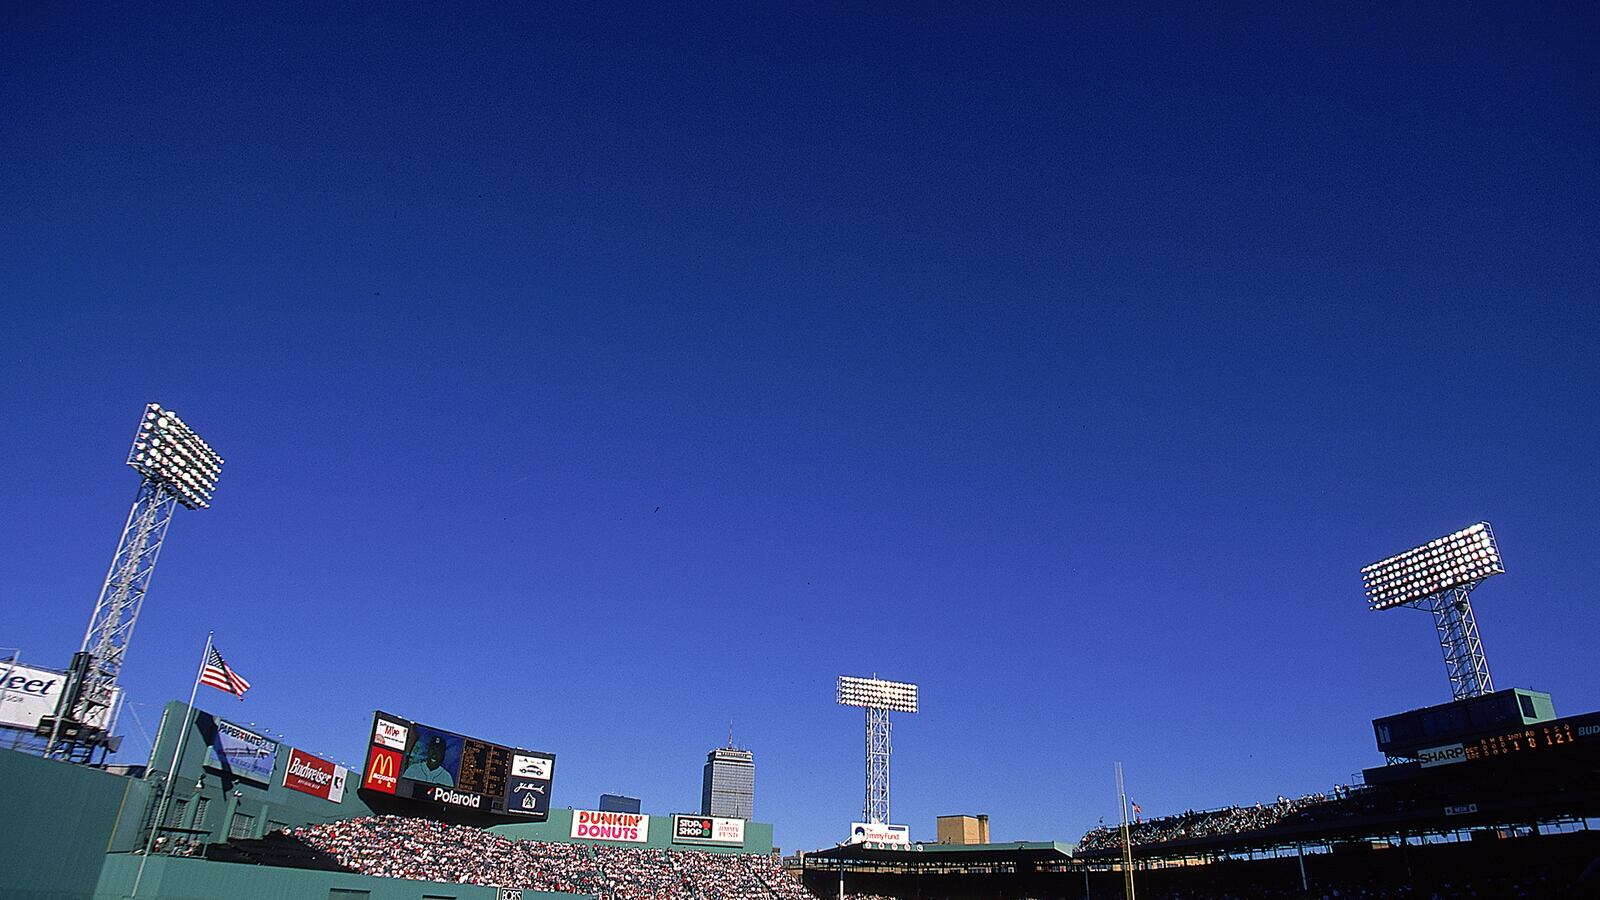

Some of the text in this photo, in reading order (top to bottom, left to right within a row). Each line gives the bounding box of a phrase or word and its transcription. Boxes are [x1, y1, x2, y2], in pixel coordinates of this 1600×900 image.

[218, 723, 240, 739] PAPER
[245, 732, 262, 747] MATE
[1514, 741, 1520, 750] 1
[1528, 738, 1536, 748] 8
[1420, 747, 1463, 763] SHARP
[288, 757, 332, 785] Budweiser
[434, 787, 480, 808] Polaroid
[578, 811, 643, 827] DUNKIN'
[678, 818, 699, 828] STOP
[578, 824, 638, 840] DONUTS
[678, 828, 702, 836] SHOP
